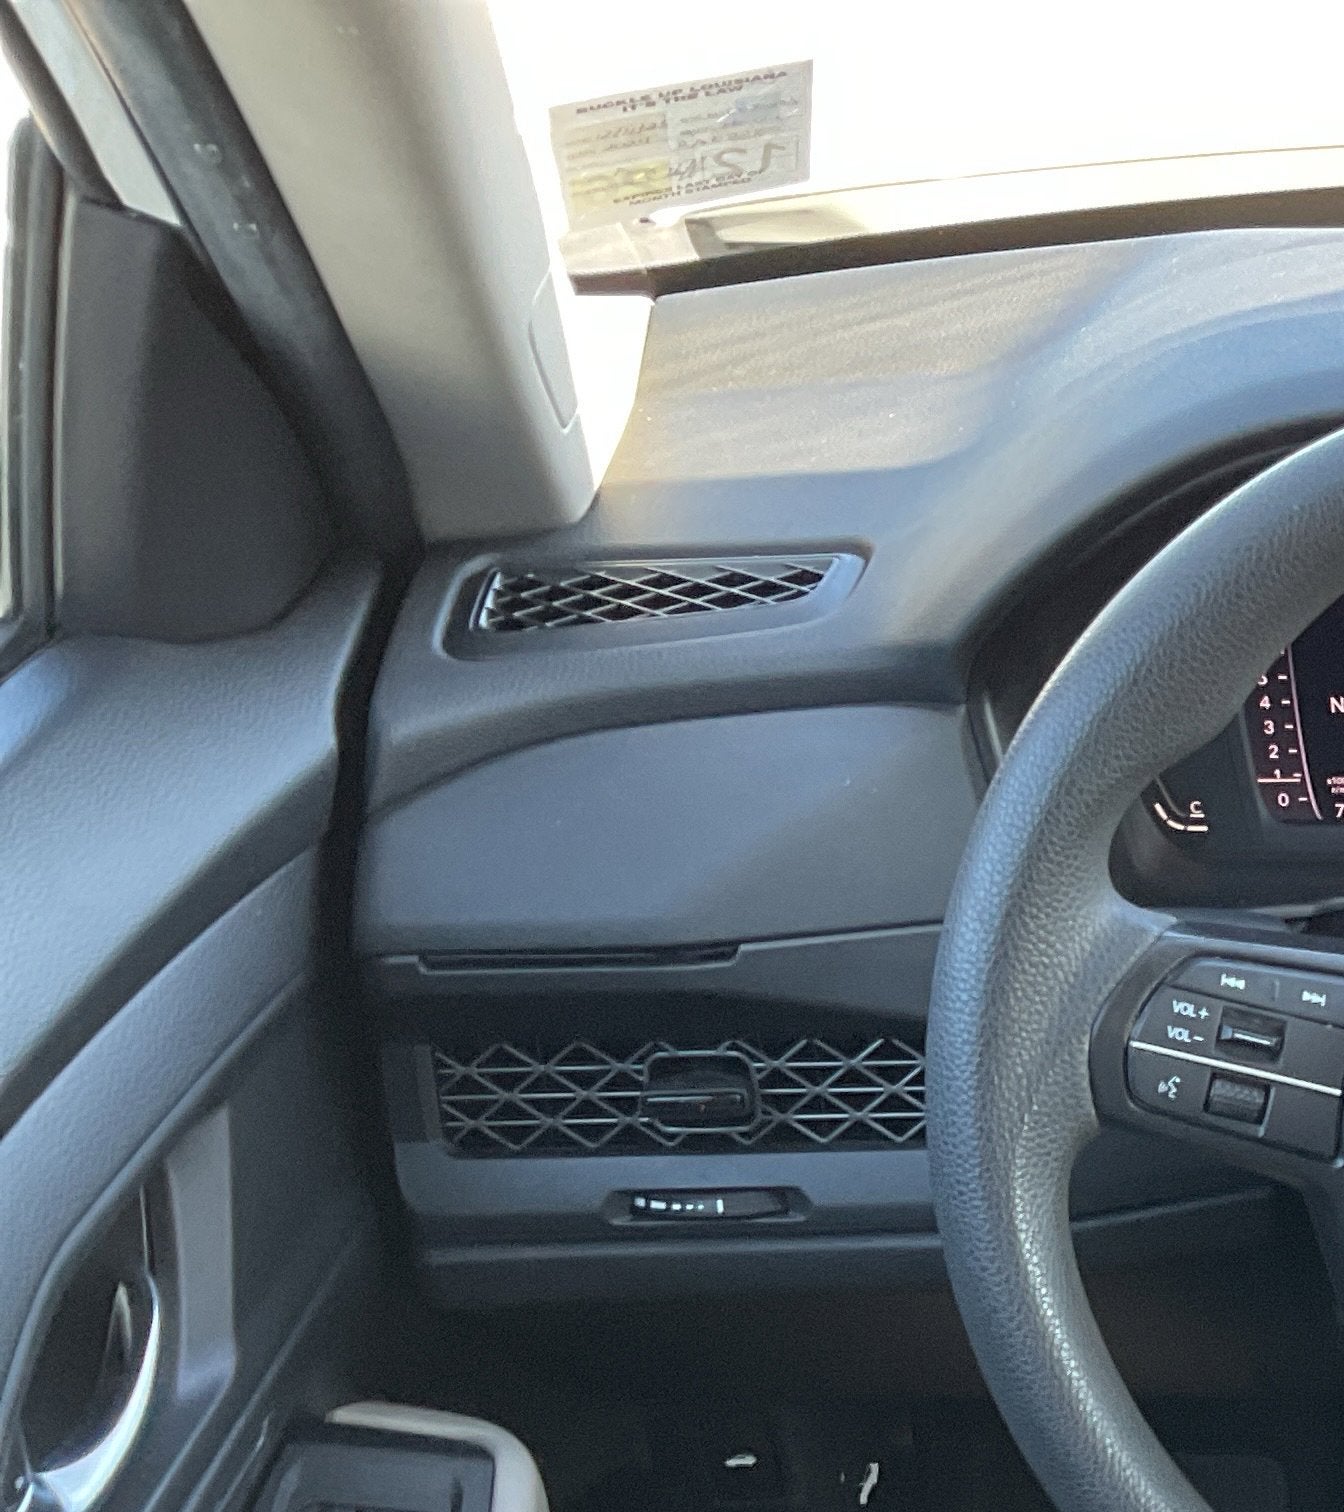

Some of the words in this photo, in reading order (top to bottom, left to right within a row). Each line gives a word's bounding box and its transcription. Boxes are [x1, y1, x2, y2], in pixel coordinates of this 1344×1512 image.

[1259, 695, 1271, 710] 4
[1263, 719, 1275, 734] 3
[1268, 744, 1280, 759] 2
[1189, 800, 1203, 814] C
[1277, 792, 1290, 807] 0
